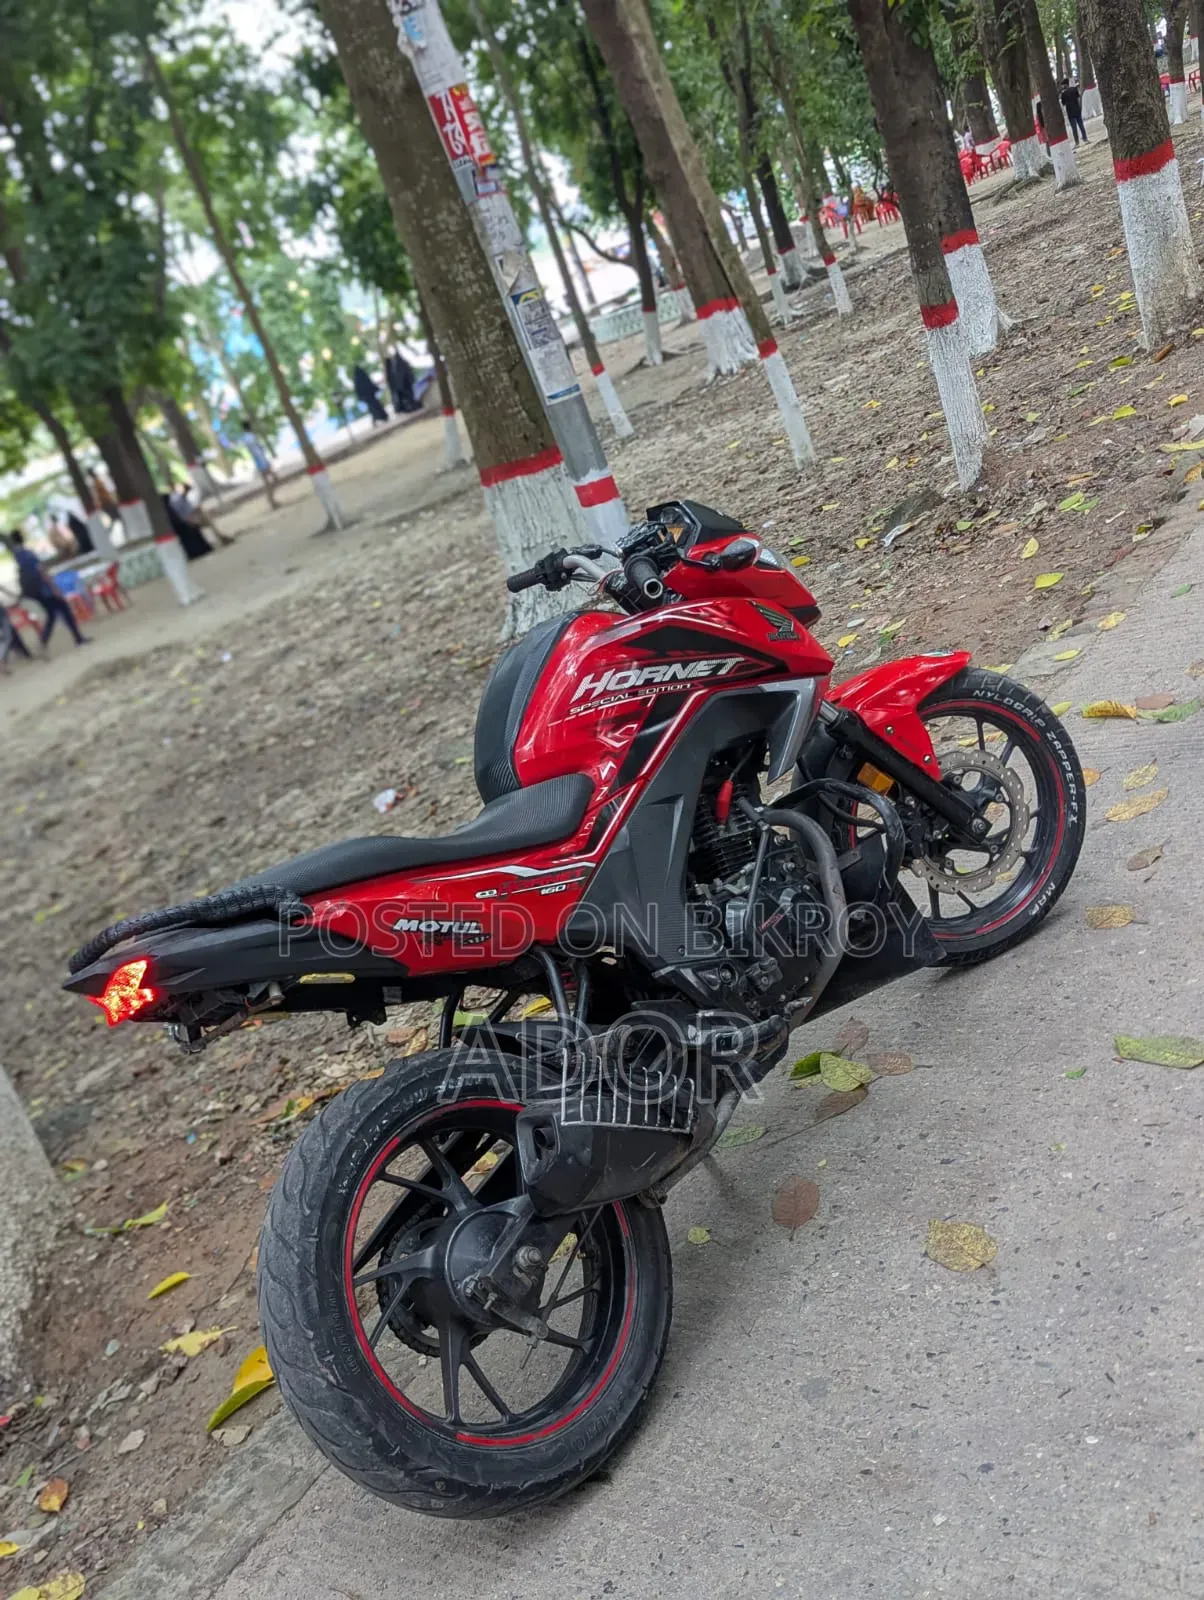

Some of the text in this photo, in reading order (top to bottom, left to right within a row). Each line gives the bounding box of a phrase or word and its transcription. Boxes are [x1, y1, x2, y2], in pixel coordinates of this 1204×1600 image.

[570, 657, 745, 704] HORNET
[570, 683, 691, 715] SPECIAL EDITION
[973, 690, 1046, 727] NYLOGRIP
[540, 884, 567, 895] 160
[393, 918, 482, 934] MOTUL
